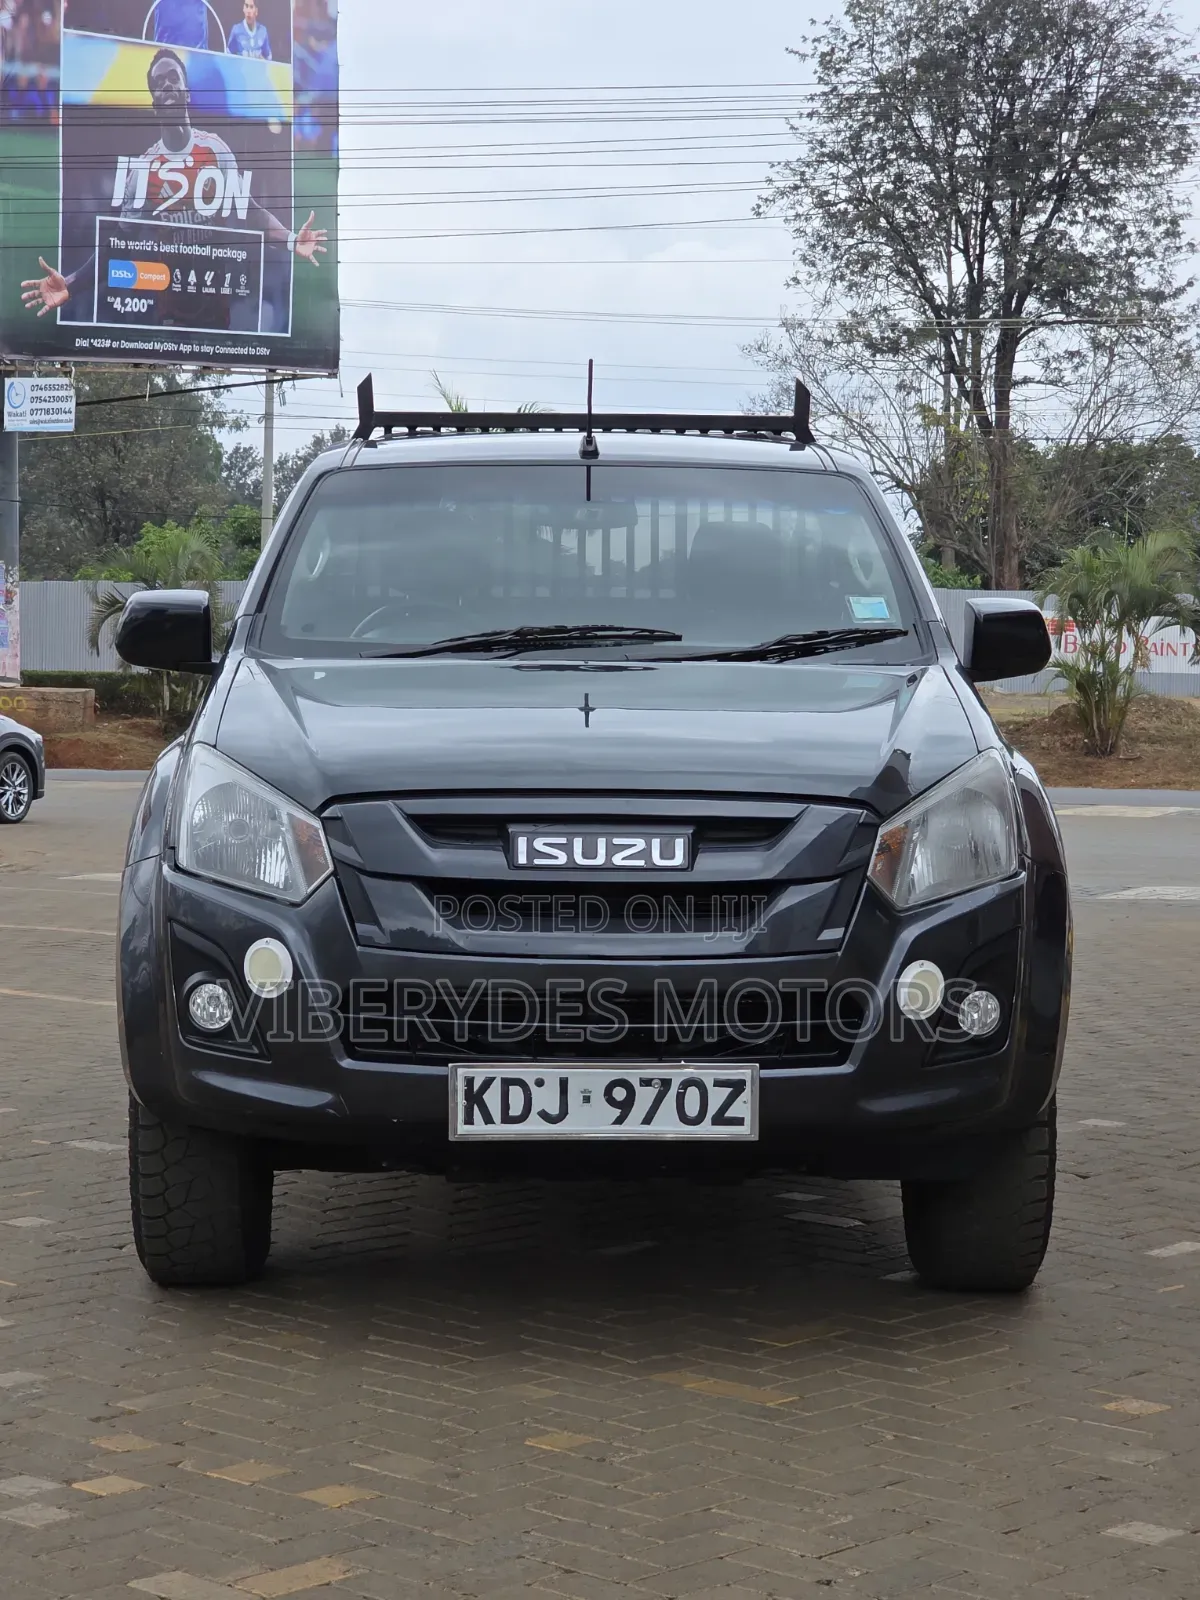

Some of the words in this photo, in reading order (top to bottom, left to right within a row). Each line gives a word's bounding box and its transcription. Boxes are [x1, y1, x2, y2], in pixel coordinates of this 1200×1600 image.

[194, 165, 253, 220] ON
[109, 237, 126, 249] The
[127, 240, 159, 252] world's
[160, 241, 178, 253] best
[179, 243, 211, 256] football
[212, 247, 247, 261] package
[111, 269, 134, 279] DStv
[139, 272, 166, 282] Compact
[113, 296, 147, 314] 4,200
[75, 338, 89, 347] Dial
[120, 340, 153, 350] Download
[154, 341, 179, 353] MyDStv
[179, 343, 192, 354] App
[193, 344, 199, 352] to
[200, 344, 214, 355] stay
[215, 345, 248, 355] Connected
[249, 346, 256, 354] to
[256, 347, 271, 356] DStv
[7, 410, 27, 418] Wakati
[29, 407, 73, 417] 0771830144
[517, 836, 685, 867] ISUZU
[463, 1076, 569, 1126] KDJ
[603, 1076, 748, 1127] 970Z
